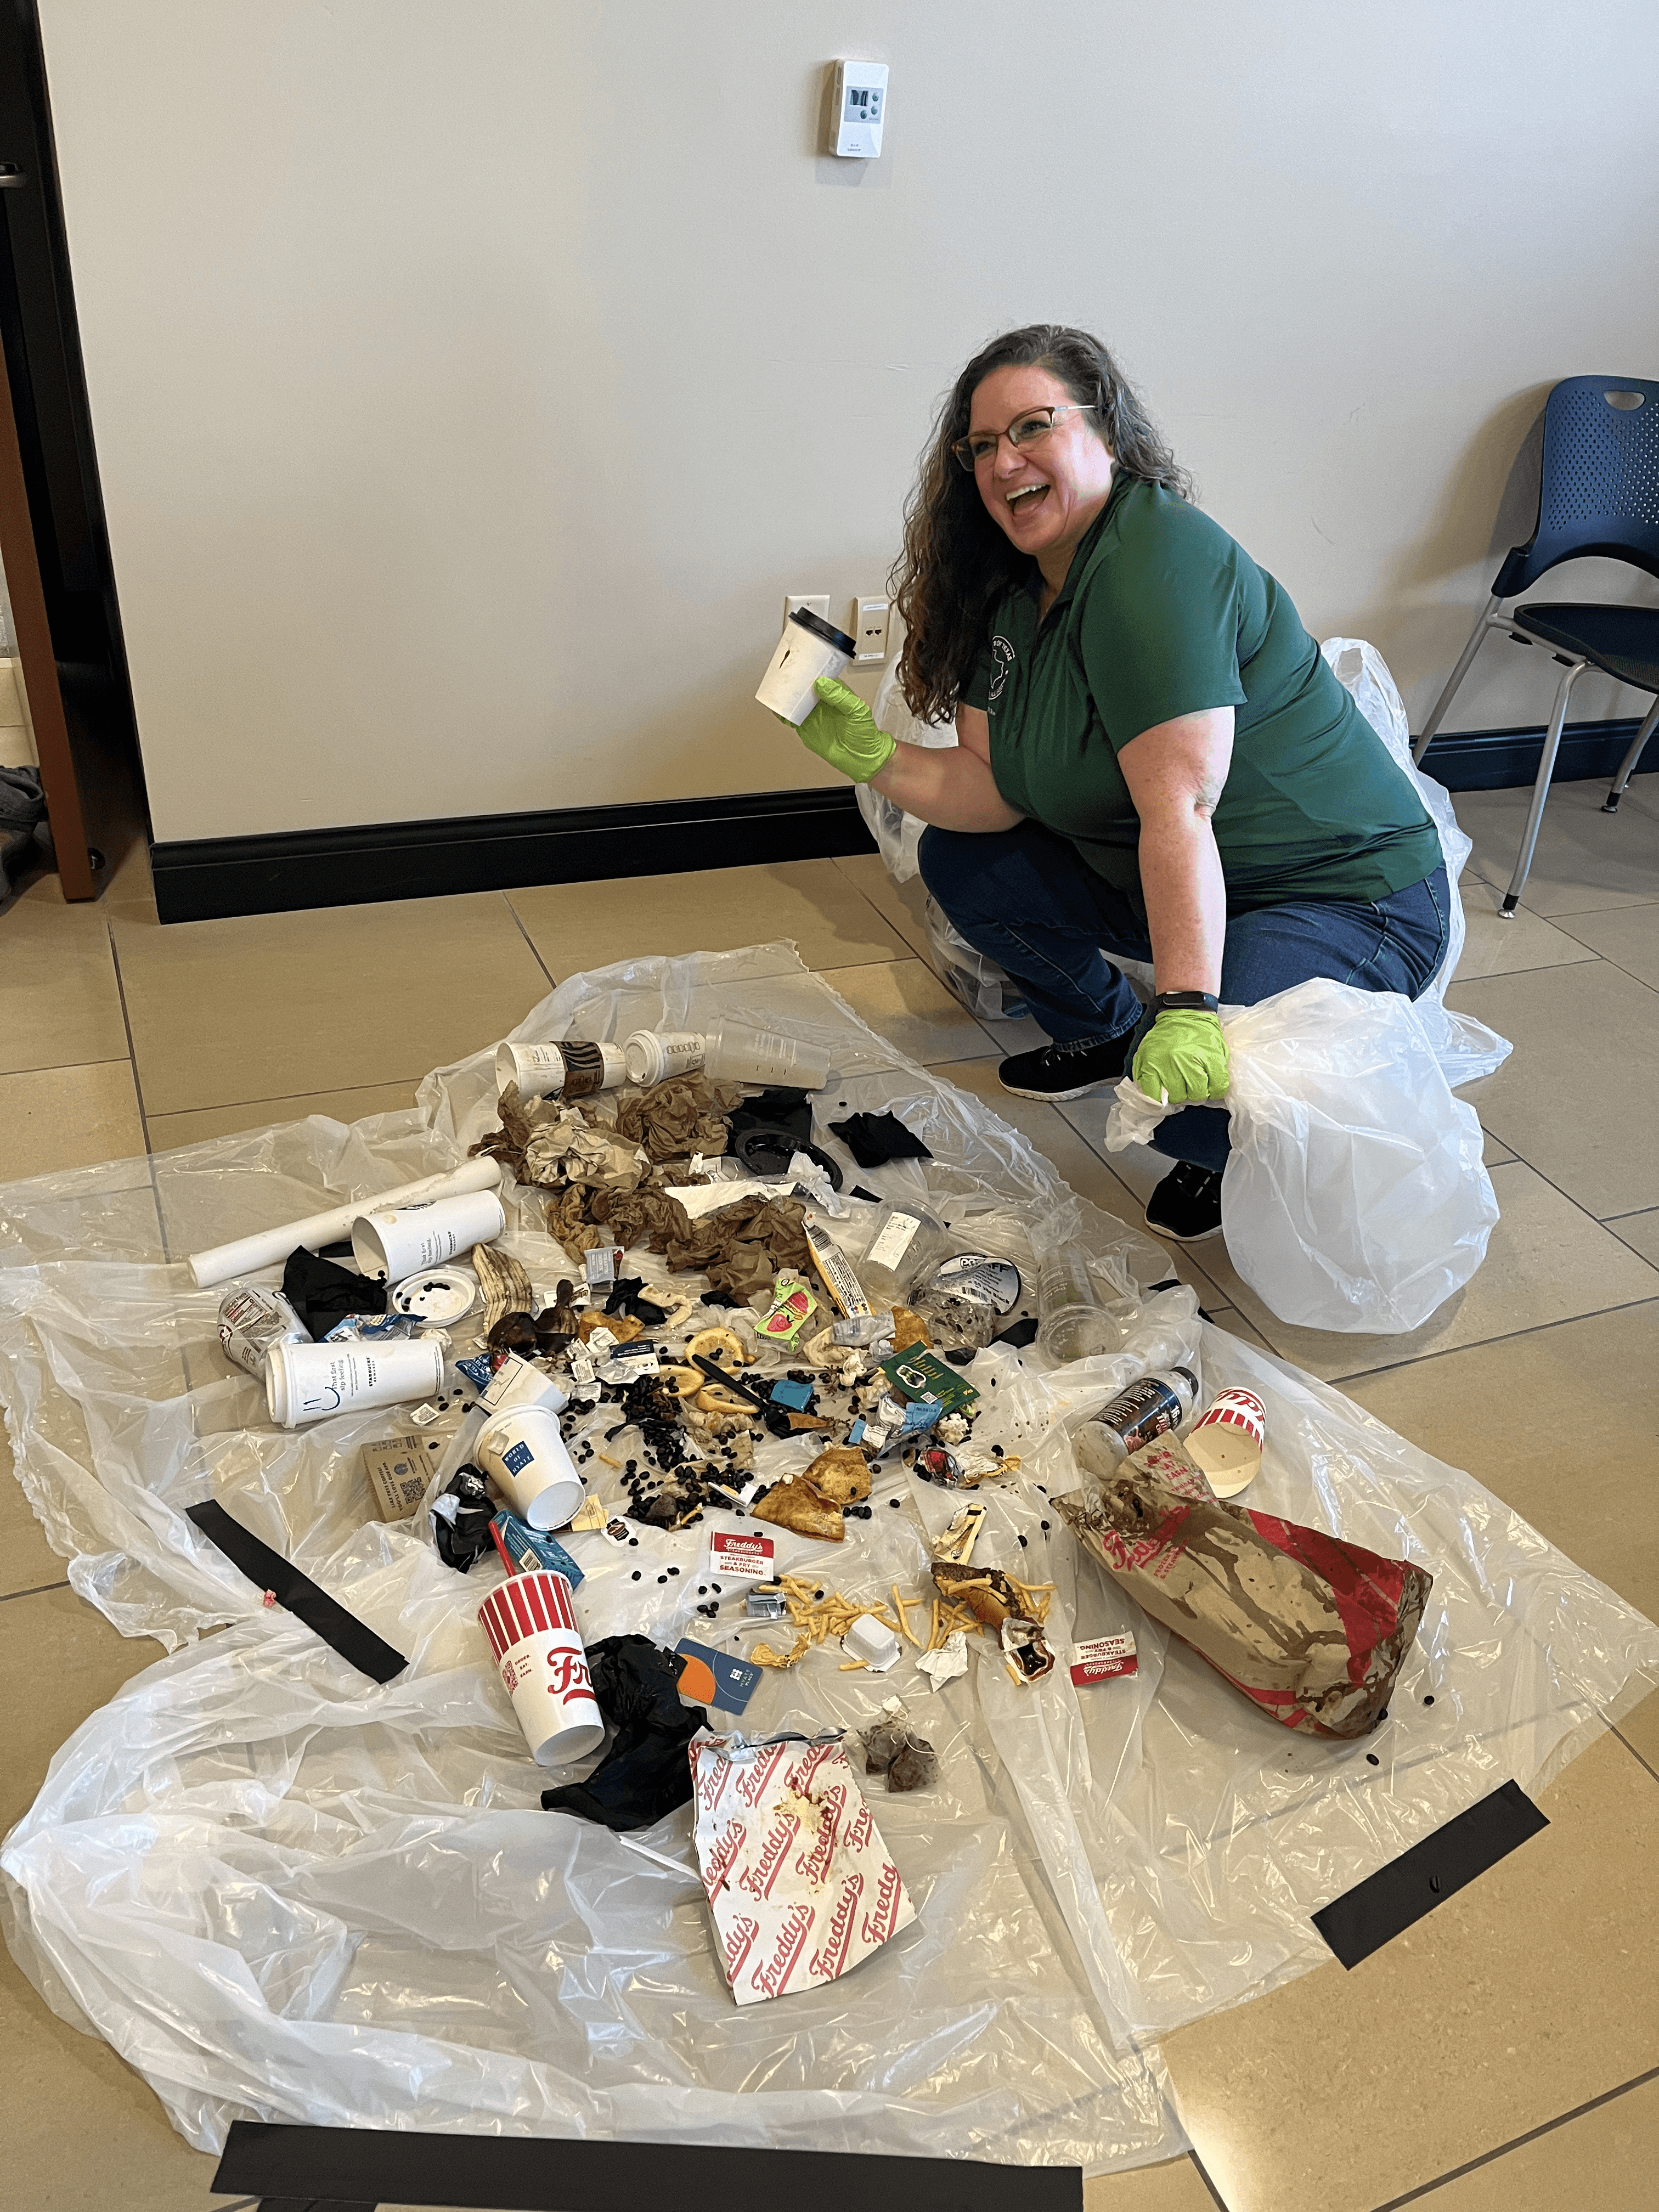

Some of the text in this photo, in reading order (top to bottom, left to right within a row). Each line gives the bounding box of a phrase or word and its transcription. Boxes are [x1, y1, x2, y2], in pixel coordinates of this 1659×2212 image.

[993, 1293, 1010, 1304] Black
[505, 1444, 524, 1462] WORLD
[512, 1456, 531, 1473] HYATT
[723, 1538, 764, 1553] Freddy's
[720, 1556, 764, 1565] STEAKBURGER
[719, 1565, 764, 1576] SEASONING
[1080, 1638, 1125, 1650] SEASONING
[1081, 1649, 1126, 1659] STEAKBURGER
[1083, 1660, 1124, 1677] Freddy's
[740, 1669, 751, 1687] HYATT
[739, 1812, 801, 1901] Freddy's
[809, 1872, 864, 1981] Freddy's
[751, 1902, 816, 1999] Freddy's
